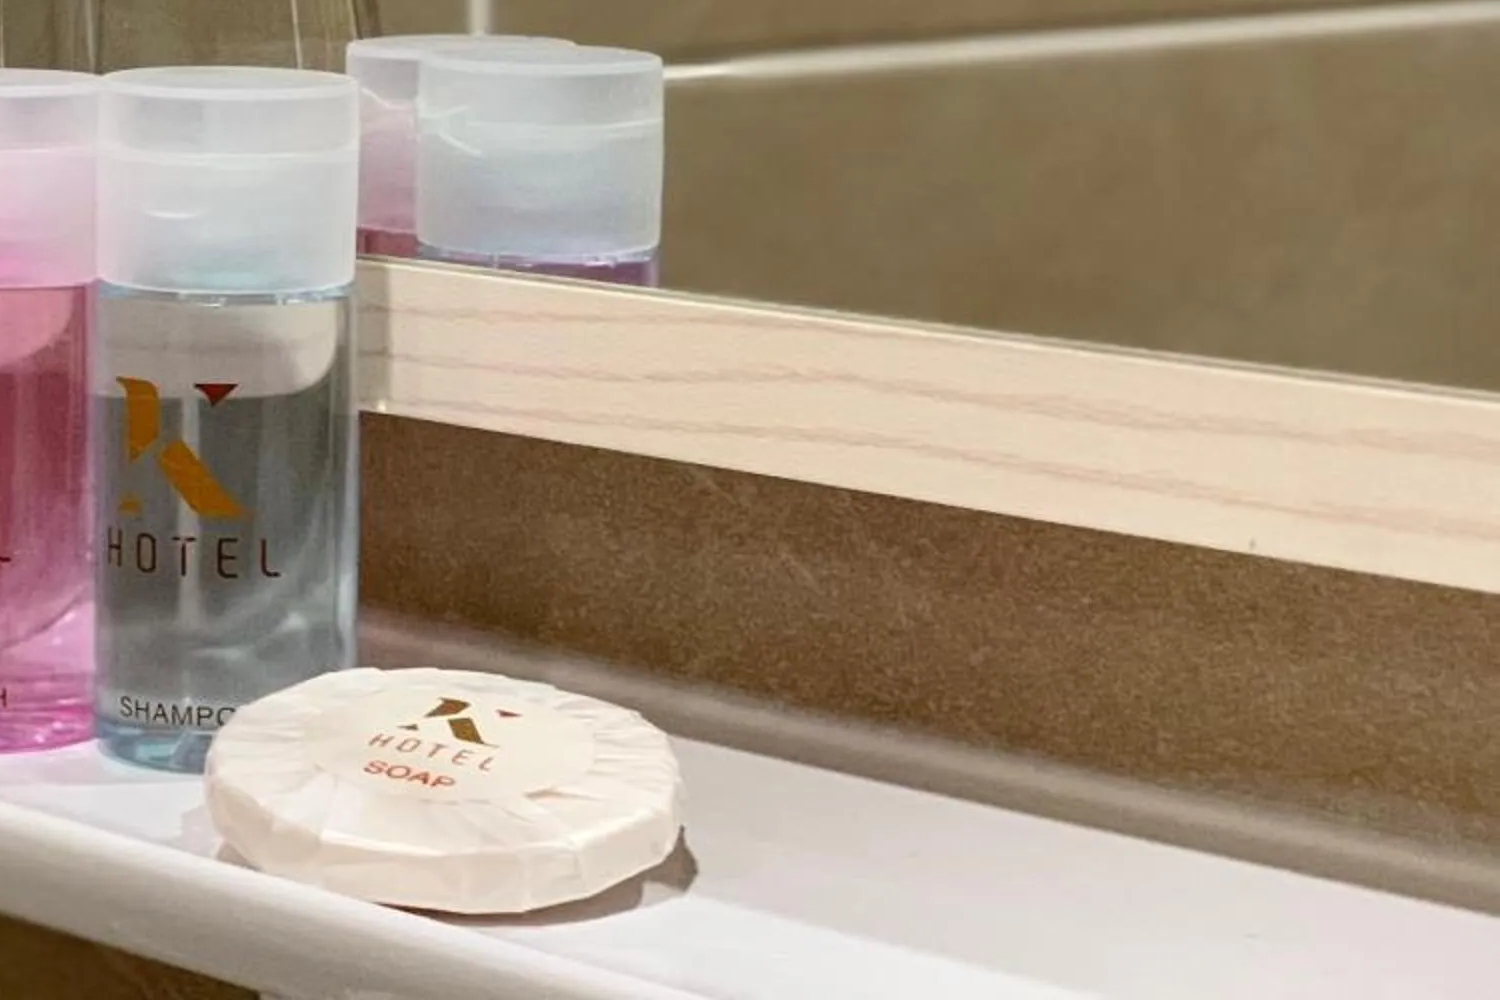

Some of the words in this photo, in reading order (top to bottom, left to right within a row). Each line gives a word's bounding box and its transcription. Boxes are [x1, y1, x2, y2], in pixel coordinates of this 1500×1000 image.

[107, 527, 282, 579] HOTEL
[119, 696, 236, 726] SHAMPO
[368, 733, 499, 771] HOTEL
[363, 760, 457, 788] SOAP
